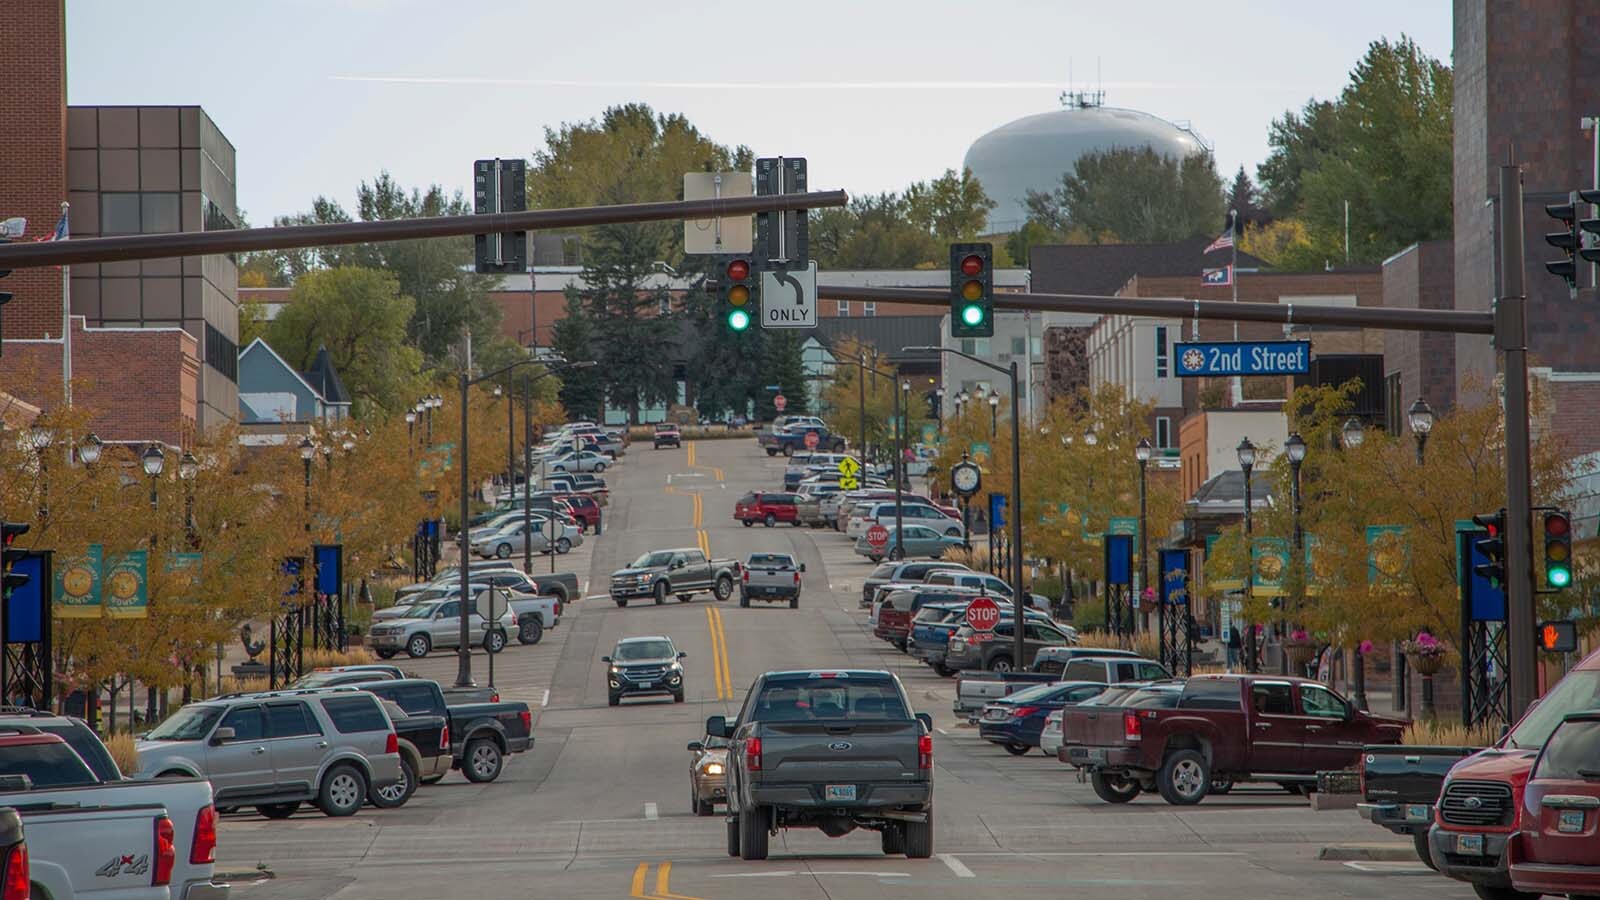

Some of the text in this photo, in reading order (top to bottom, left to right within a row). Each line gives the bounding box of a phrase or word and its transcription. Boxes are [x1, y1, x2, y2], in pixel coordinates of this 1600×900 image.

[770, 309, 808, 321] ONLY
[1209, 346, 1304, 371] 2nd Street
[868, 531, 888, 541] STOP
[969, 608, 998, 621] STOP
